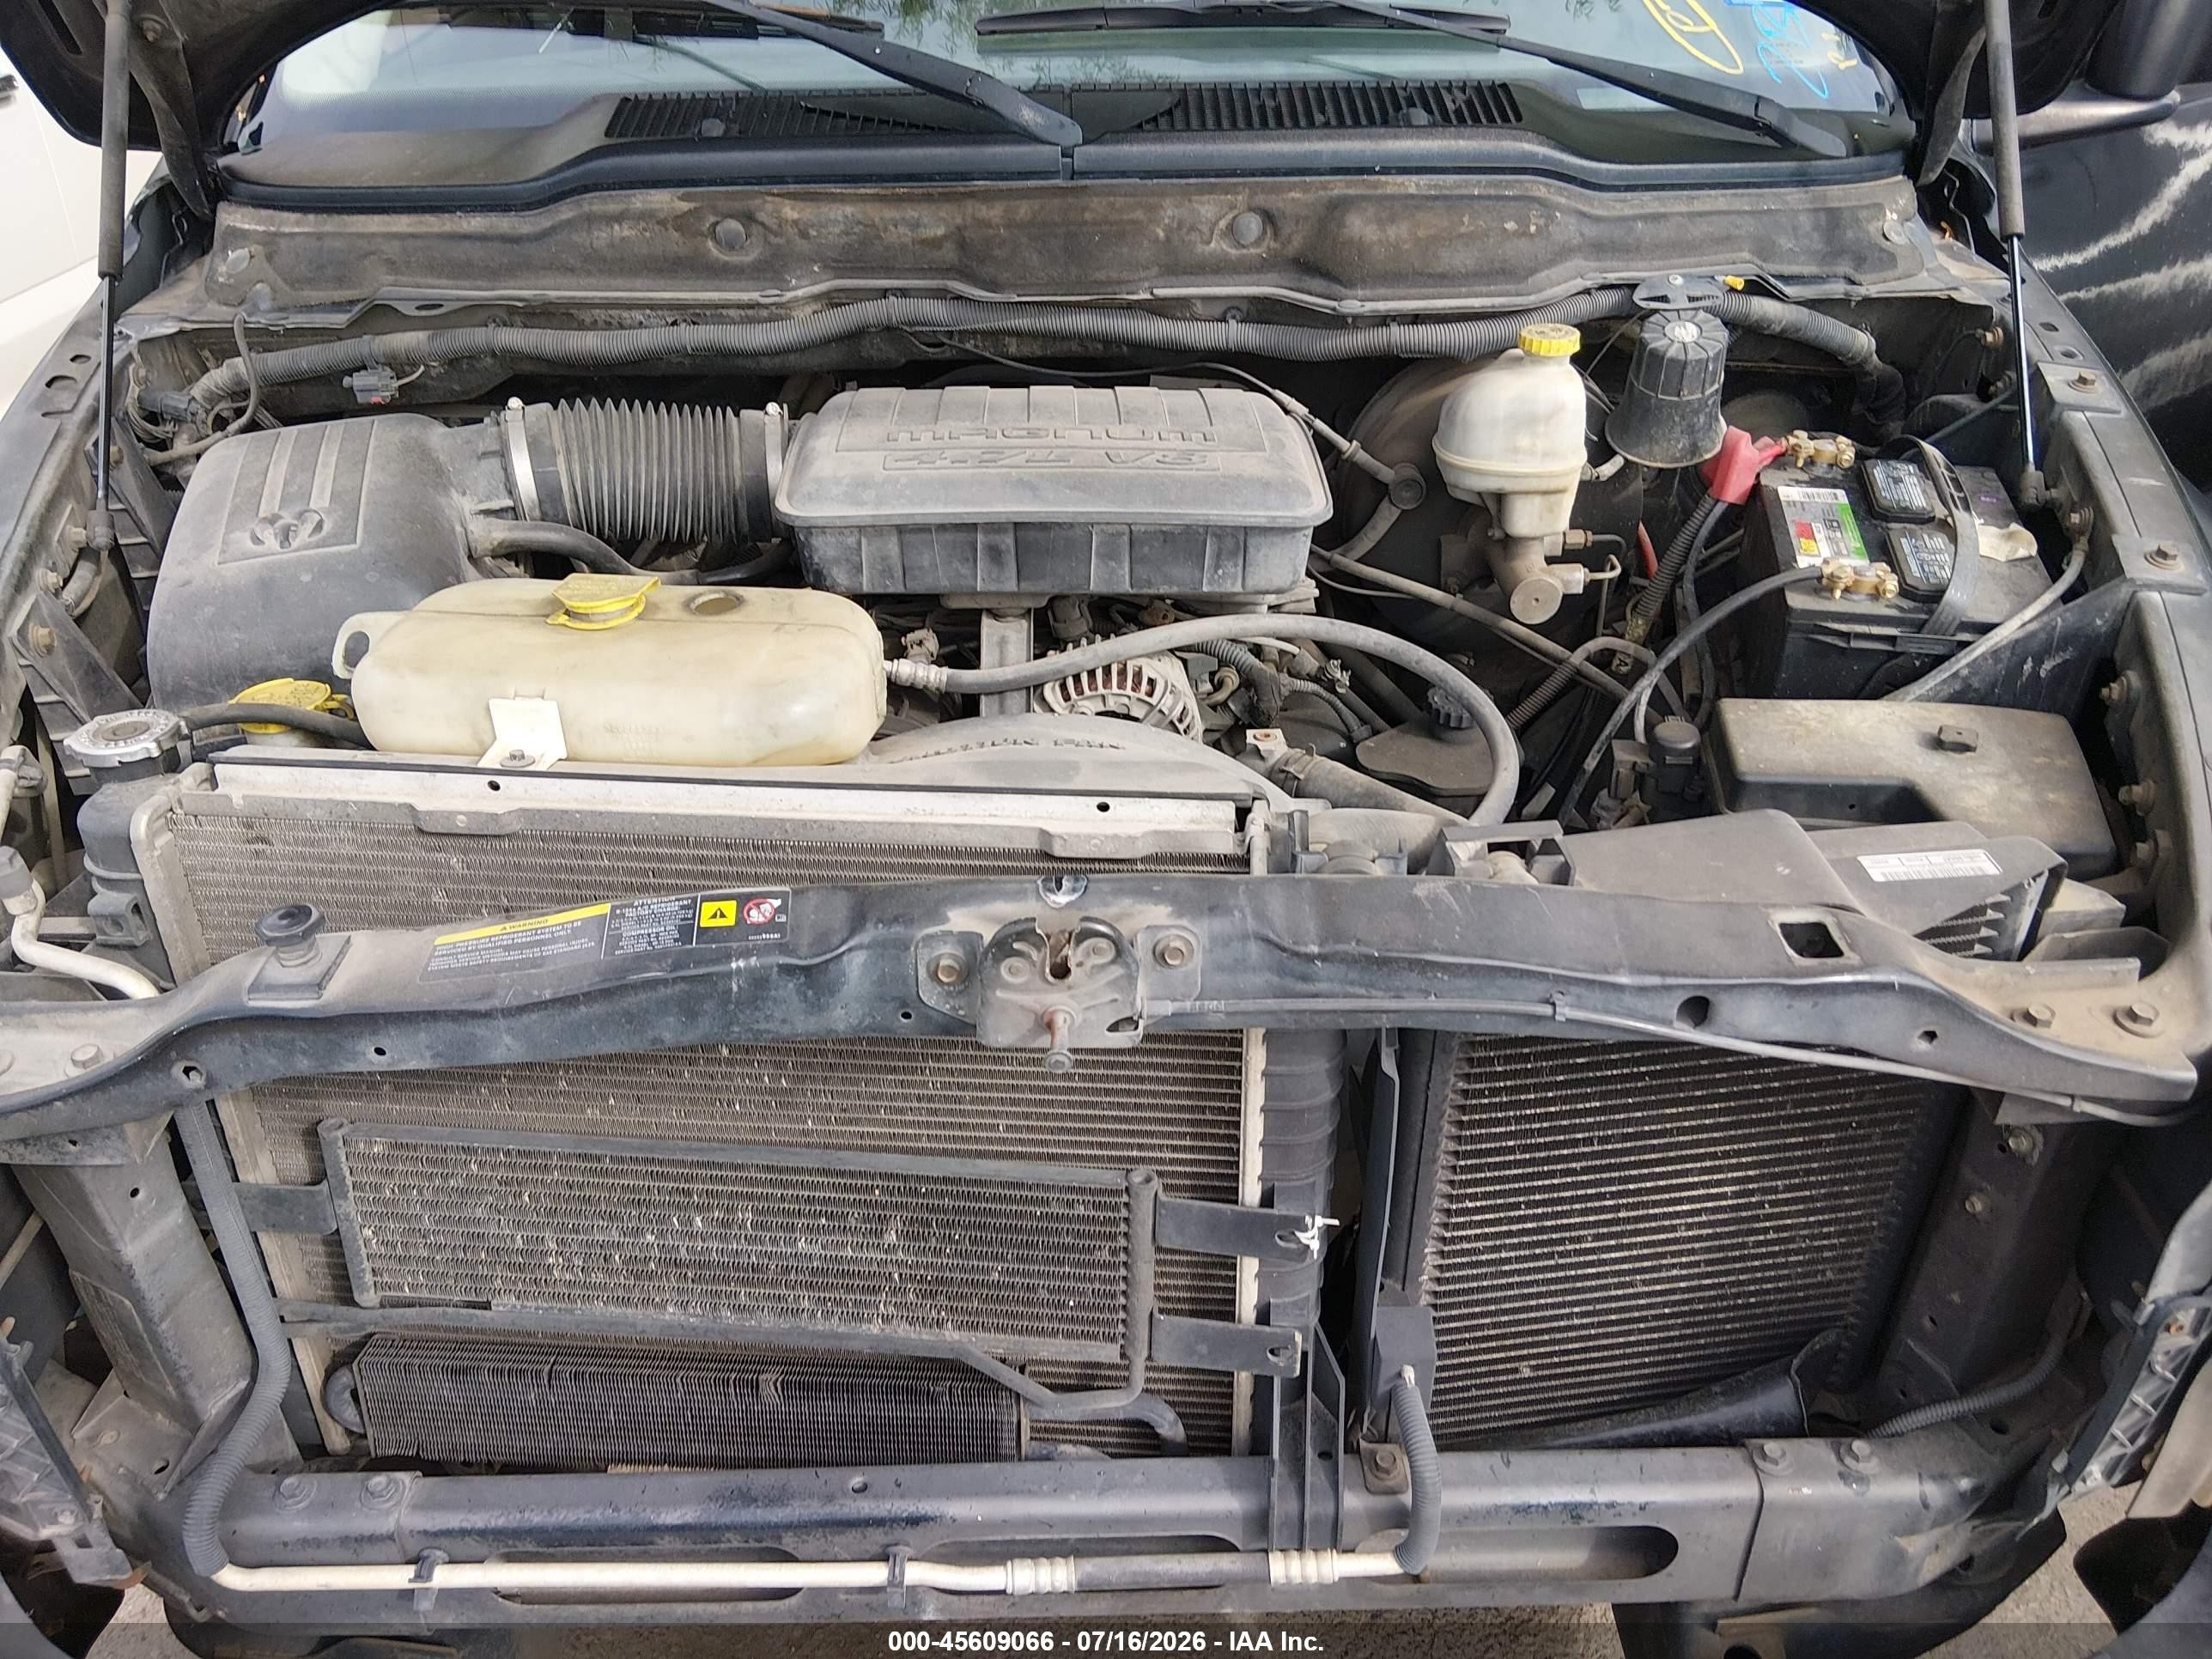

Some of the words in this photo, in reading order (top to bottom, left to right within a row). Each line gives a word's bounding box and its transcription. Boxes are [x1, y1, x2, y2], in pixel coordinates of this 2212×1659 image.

[887, 427, 1217, 442] MAGNUM
[508, 919, 549, 930] WARNING
[514, 933, 552, 945] PERSONNEL
